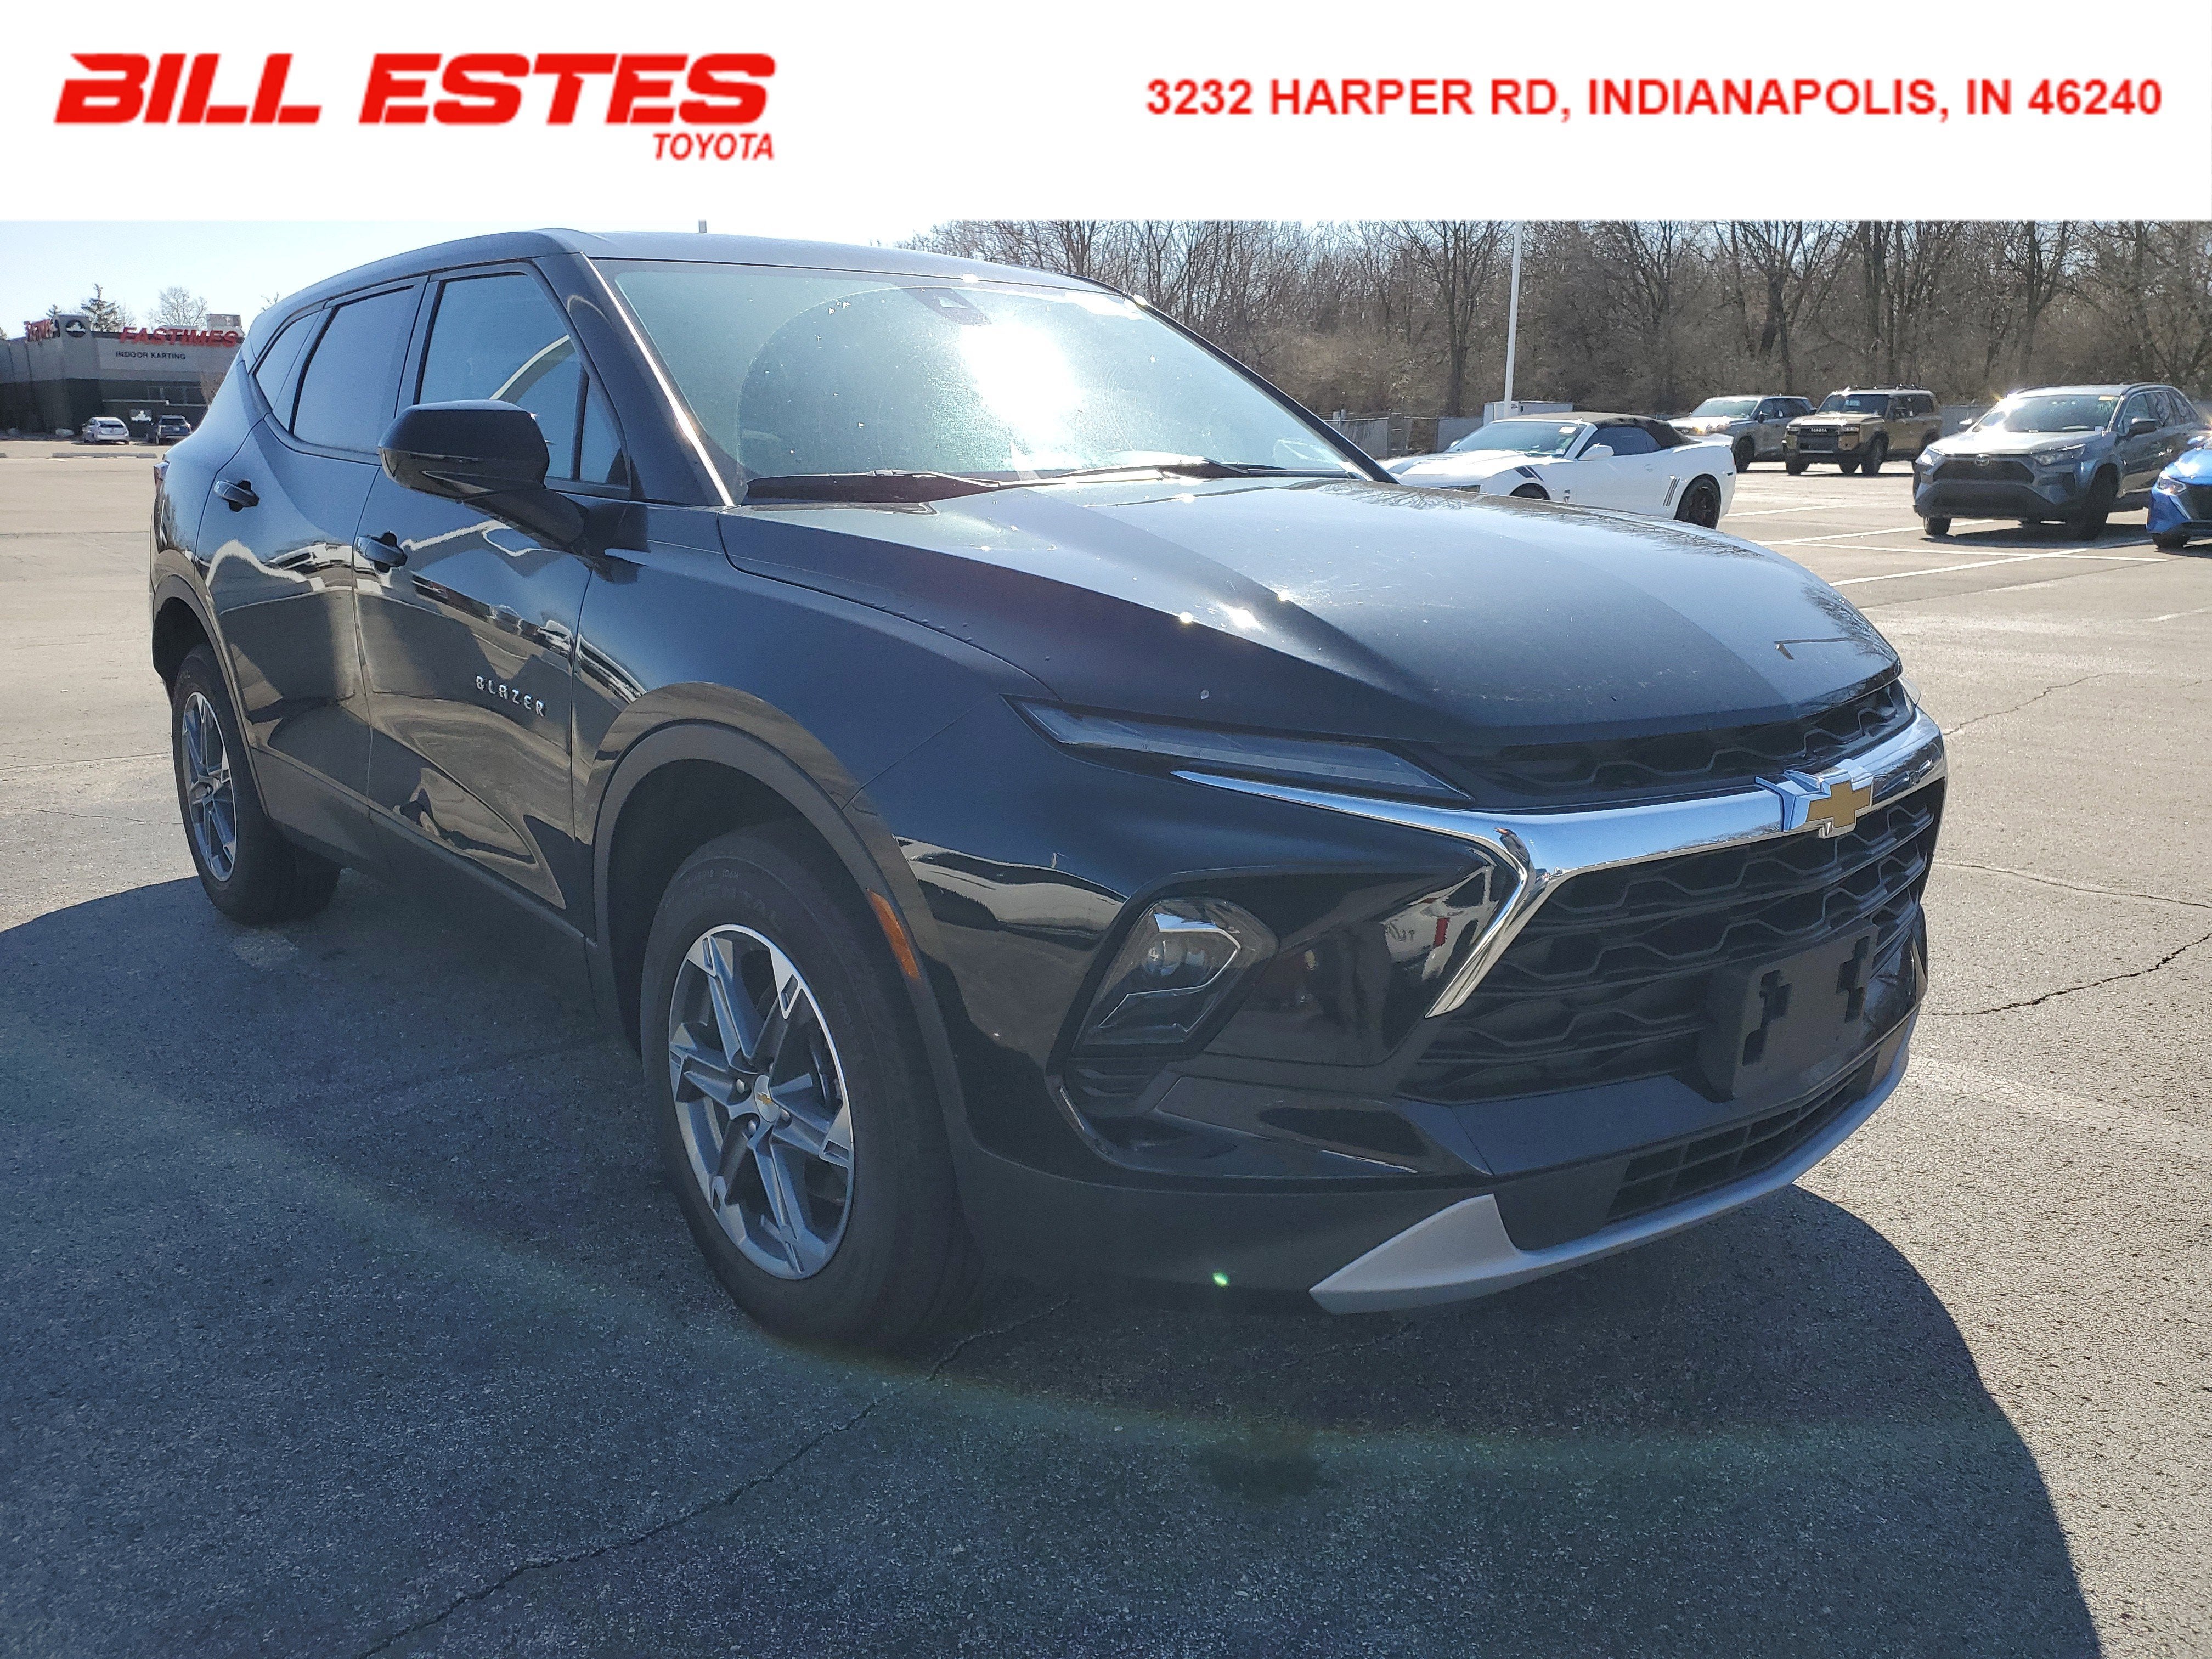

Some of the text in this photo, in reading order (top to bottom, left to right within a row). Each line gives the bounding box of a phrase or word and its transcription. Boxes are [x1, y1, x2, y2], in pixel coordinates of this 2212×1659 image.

[119, 326, 239, 347] FASTIMES
[150, 352, 186, 360] KARTING
[476, 675, 545, 717] BLAZER
